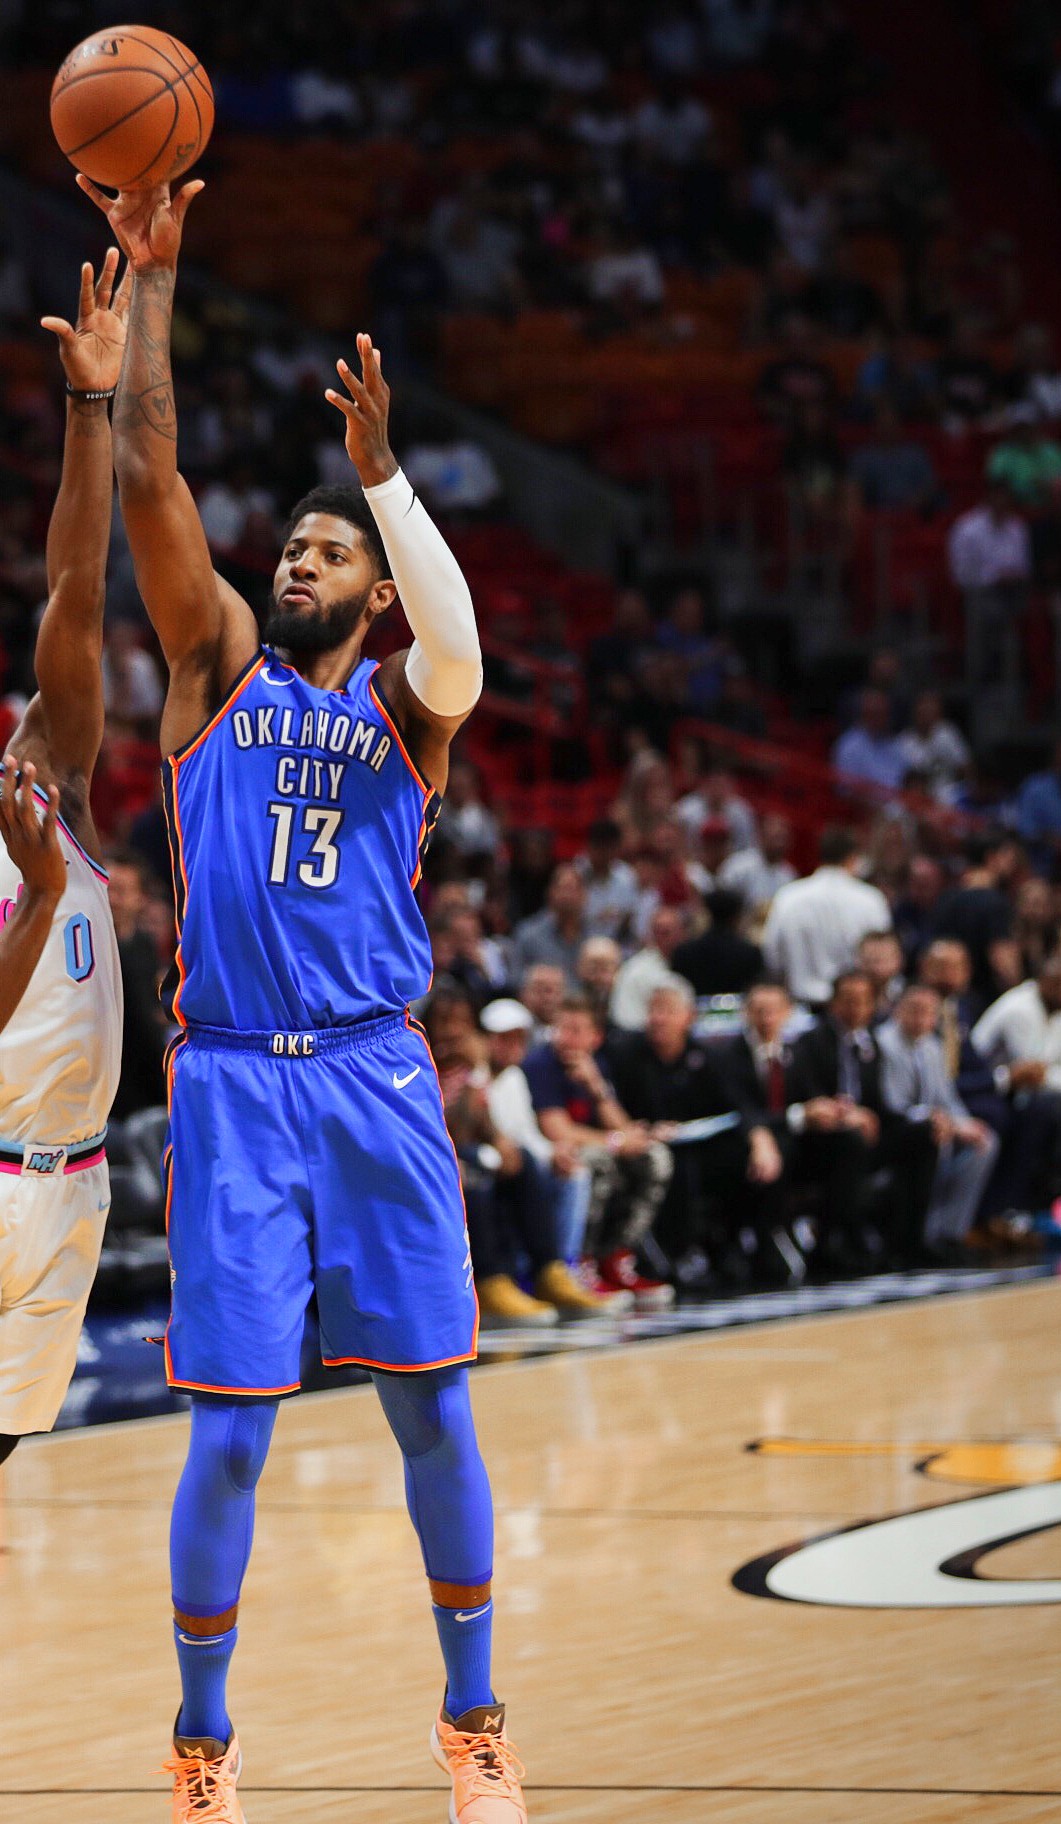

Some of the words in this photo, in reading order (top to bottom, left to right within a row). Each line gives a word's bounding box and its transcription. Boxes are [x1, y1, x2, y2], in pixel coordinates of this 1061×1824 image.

[232, 704, 392, 773] OKLAHOMA
[275, 754, 347, 801] CITY
[266, 802, 346, 891] 13
[63, 912, 96, 984] 0
[271, 1032, 315, 1056] OKC
